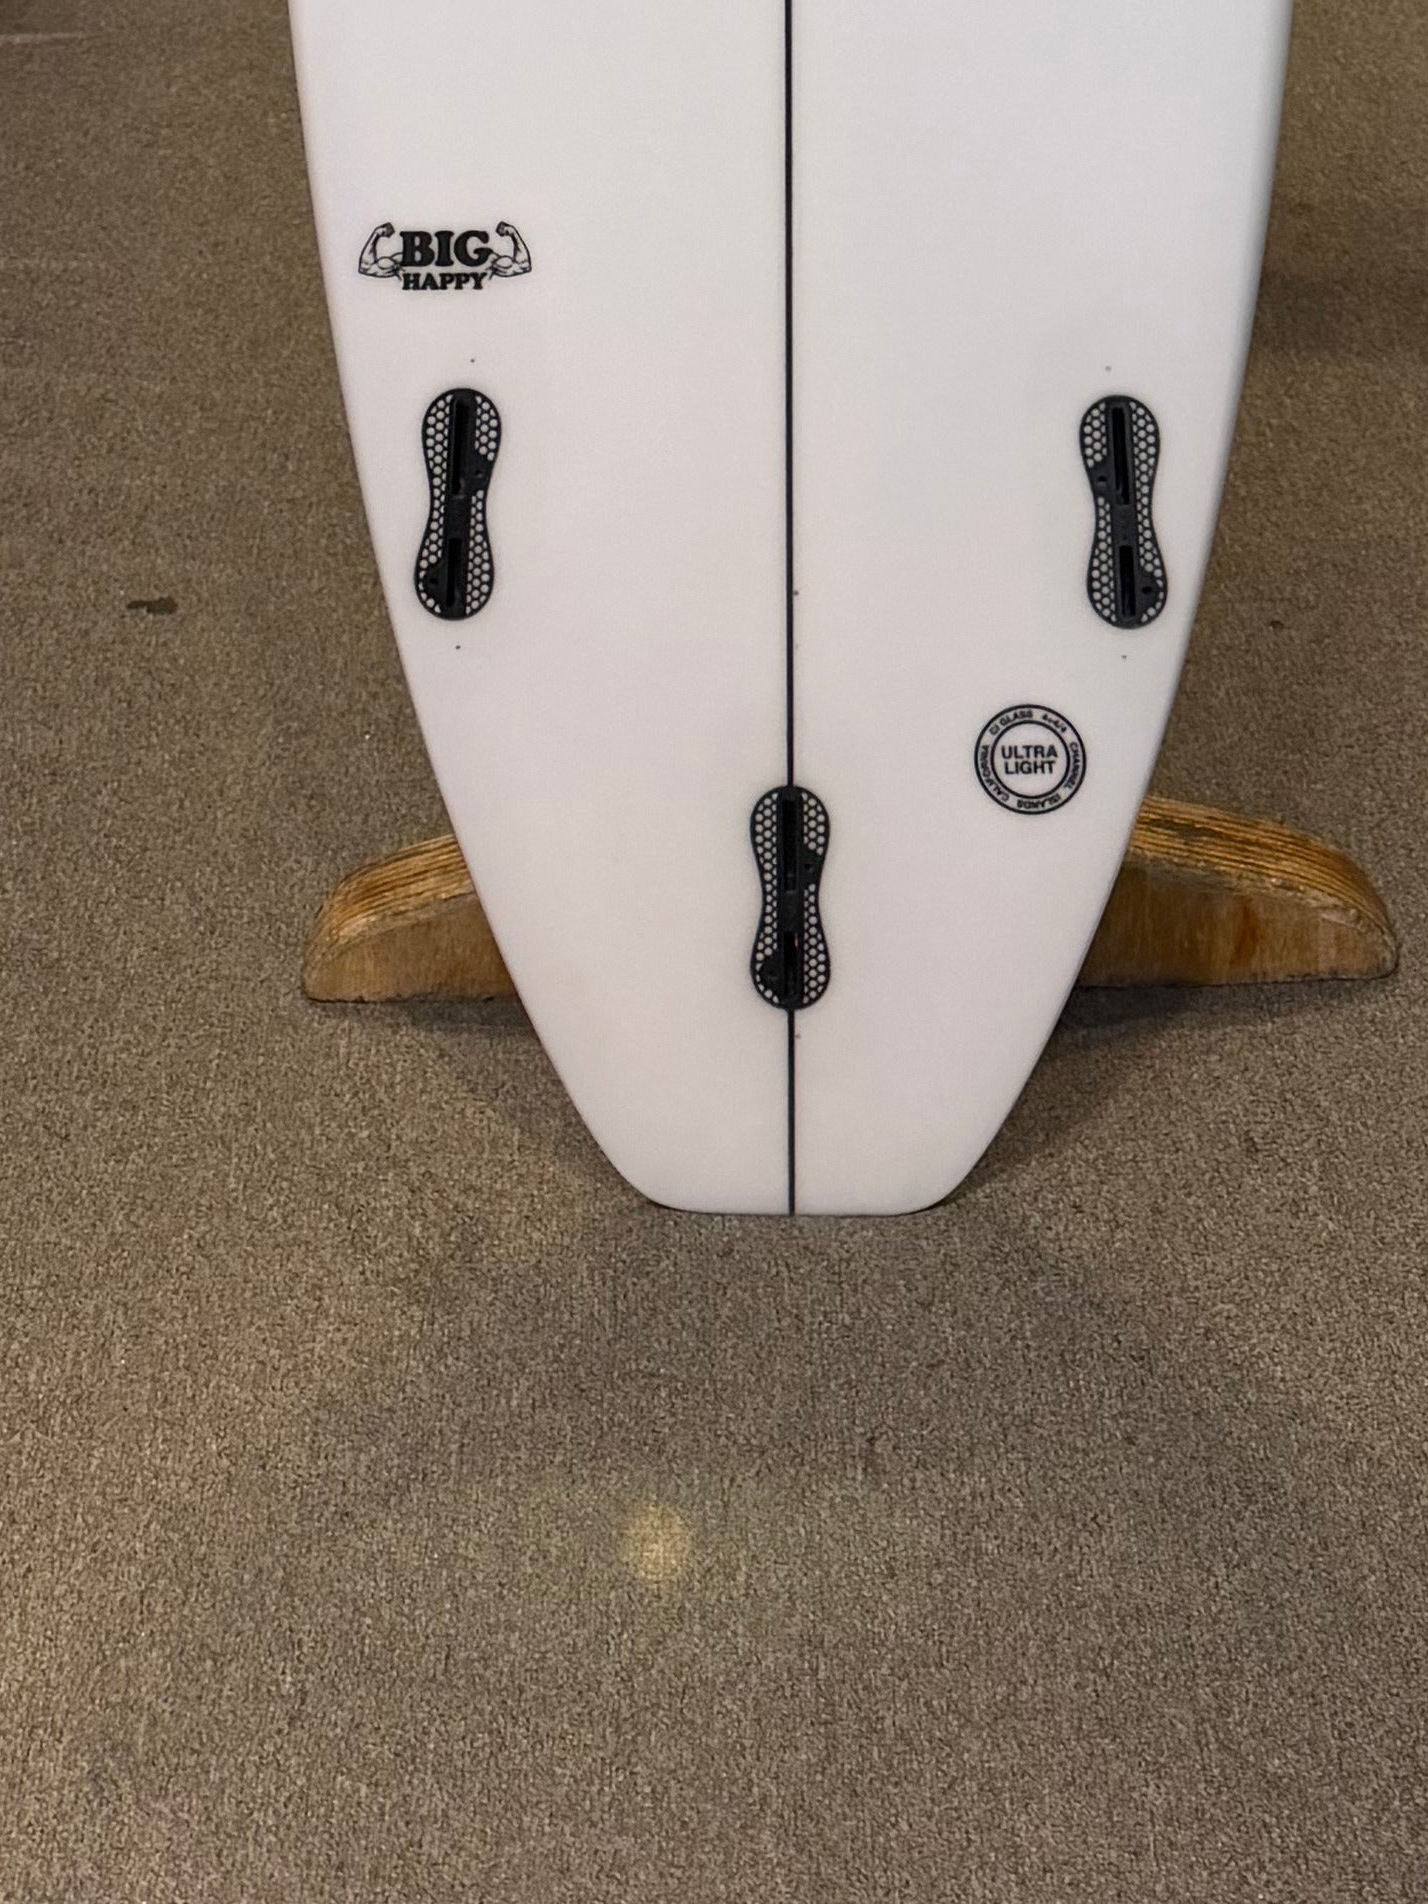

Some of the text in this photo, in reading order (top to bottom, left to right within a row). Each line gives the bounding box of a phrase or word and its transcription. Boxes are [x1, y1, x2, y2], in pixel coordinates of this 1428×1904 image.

[400, 229, 494, 267] BIG
[401, 271, 488, 291] HAPPY
[999, 710, 1033, 727] GLASS
[1001, 744, 1058, 759] ULTRA
[979, 741, 1080, 809] CHANNEL ISLANDS CALIFORNIA
[1003, 760, 1056, 775] LIGHT
